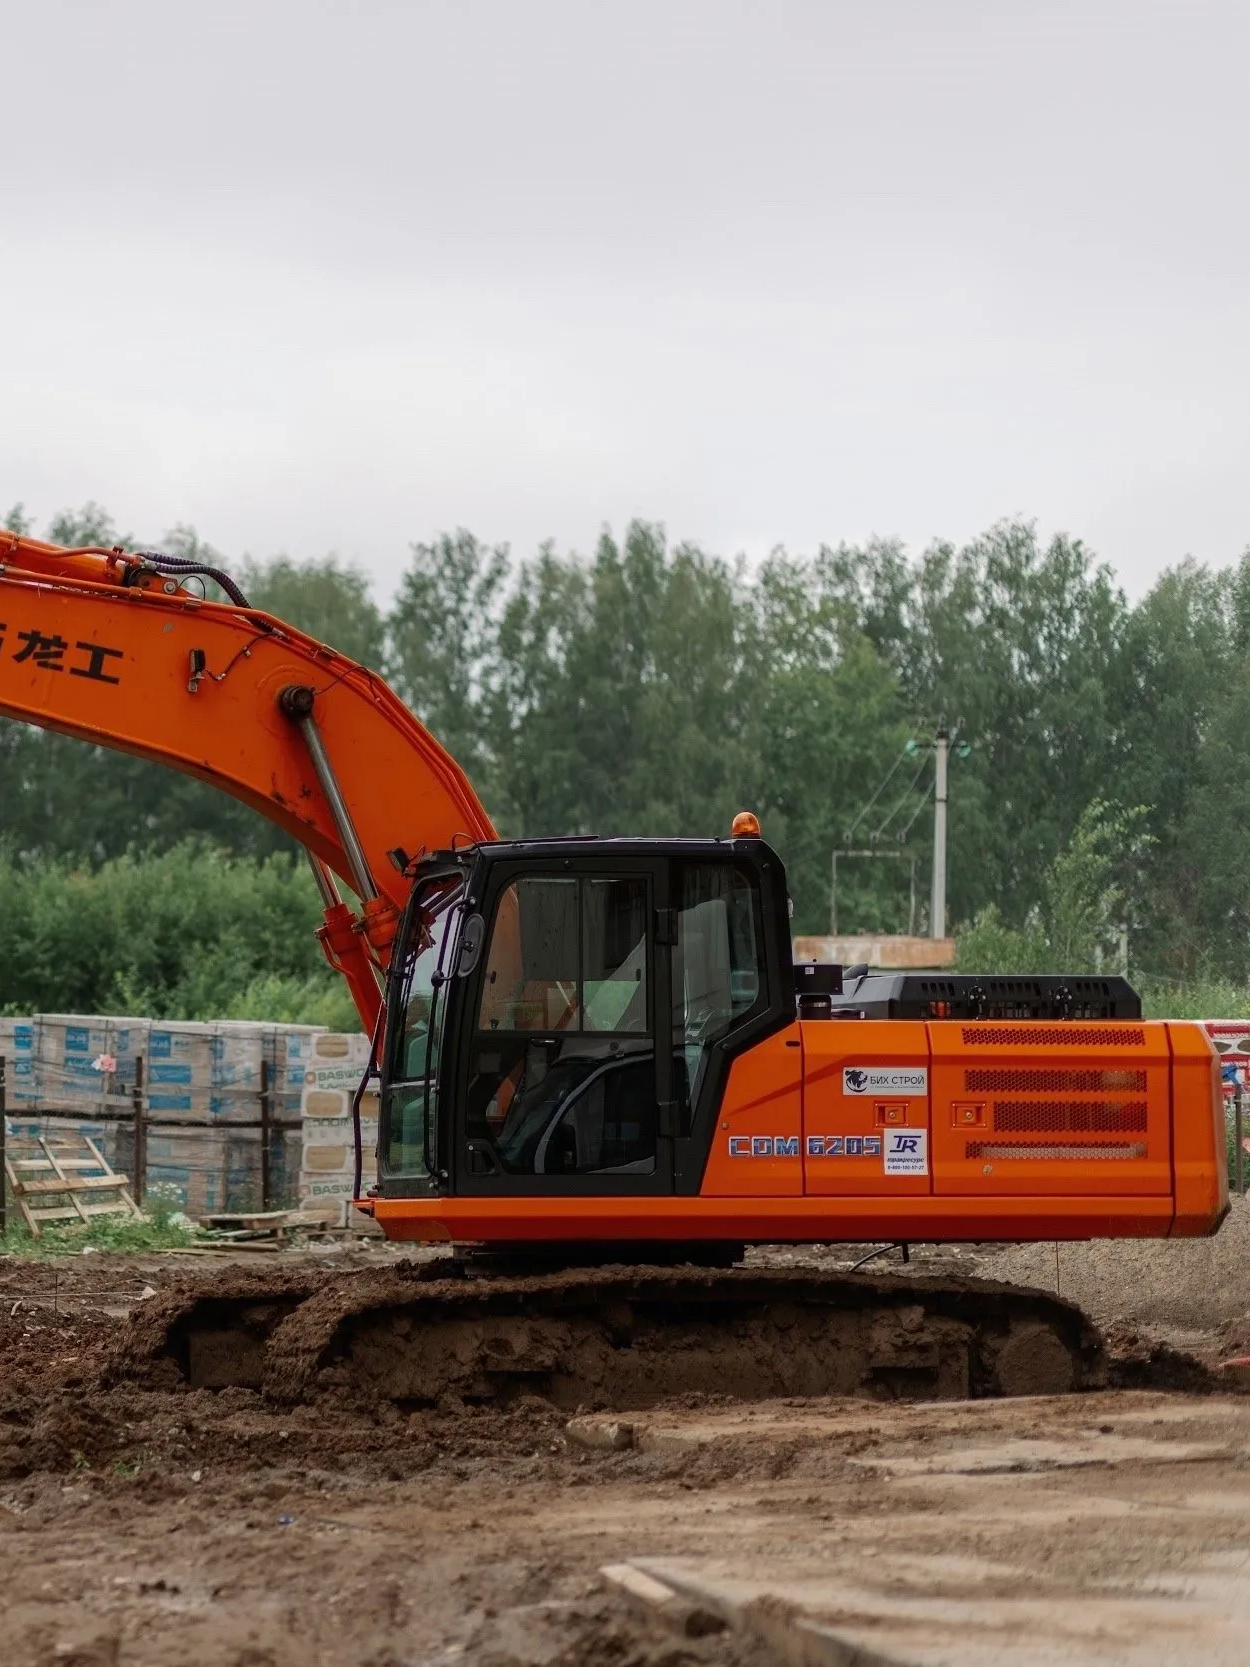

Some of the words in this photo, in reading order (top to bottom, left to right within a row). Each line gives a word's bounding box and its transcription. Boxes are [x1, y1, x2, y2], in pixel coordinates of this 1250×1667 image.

[12, 630, 125, 685] 龙工
[870, 1076, 889, 1085] БИХ
[891, 1074, 925, 1085] СТРОЙ
[729, 1136, 799, 1156] CDM
[806, 1136, 881, 1156] 6205
